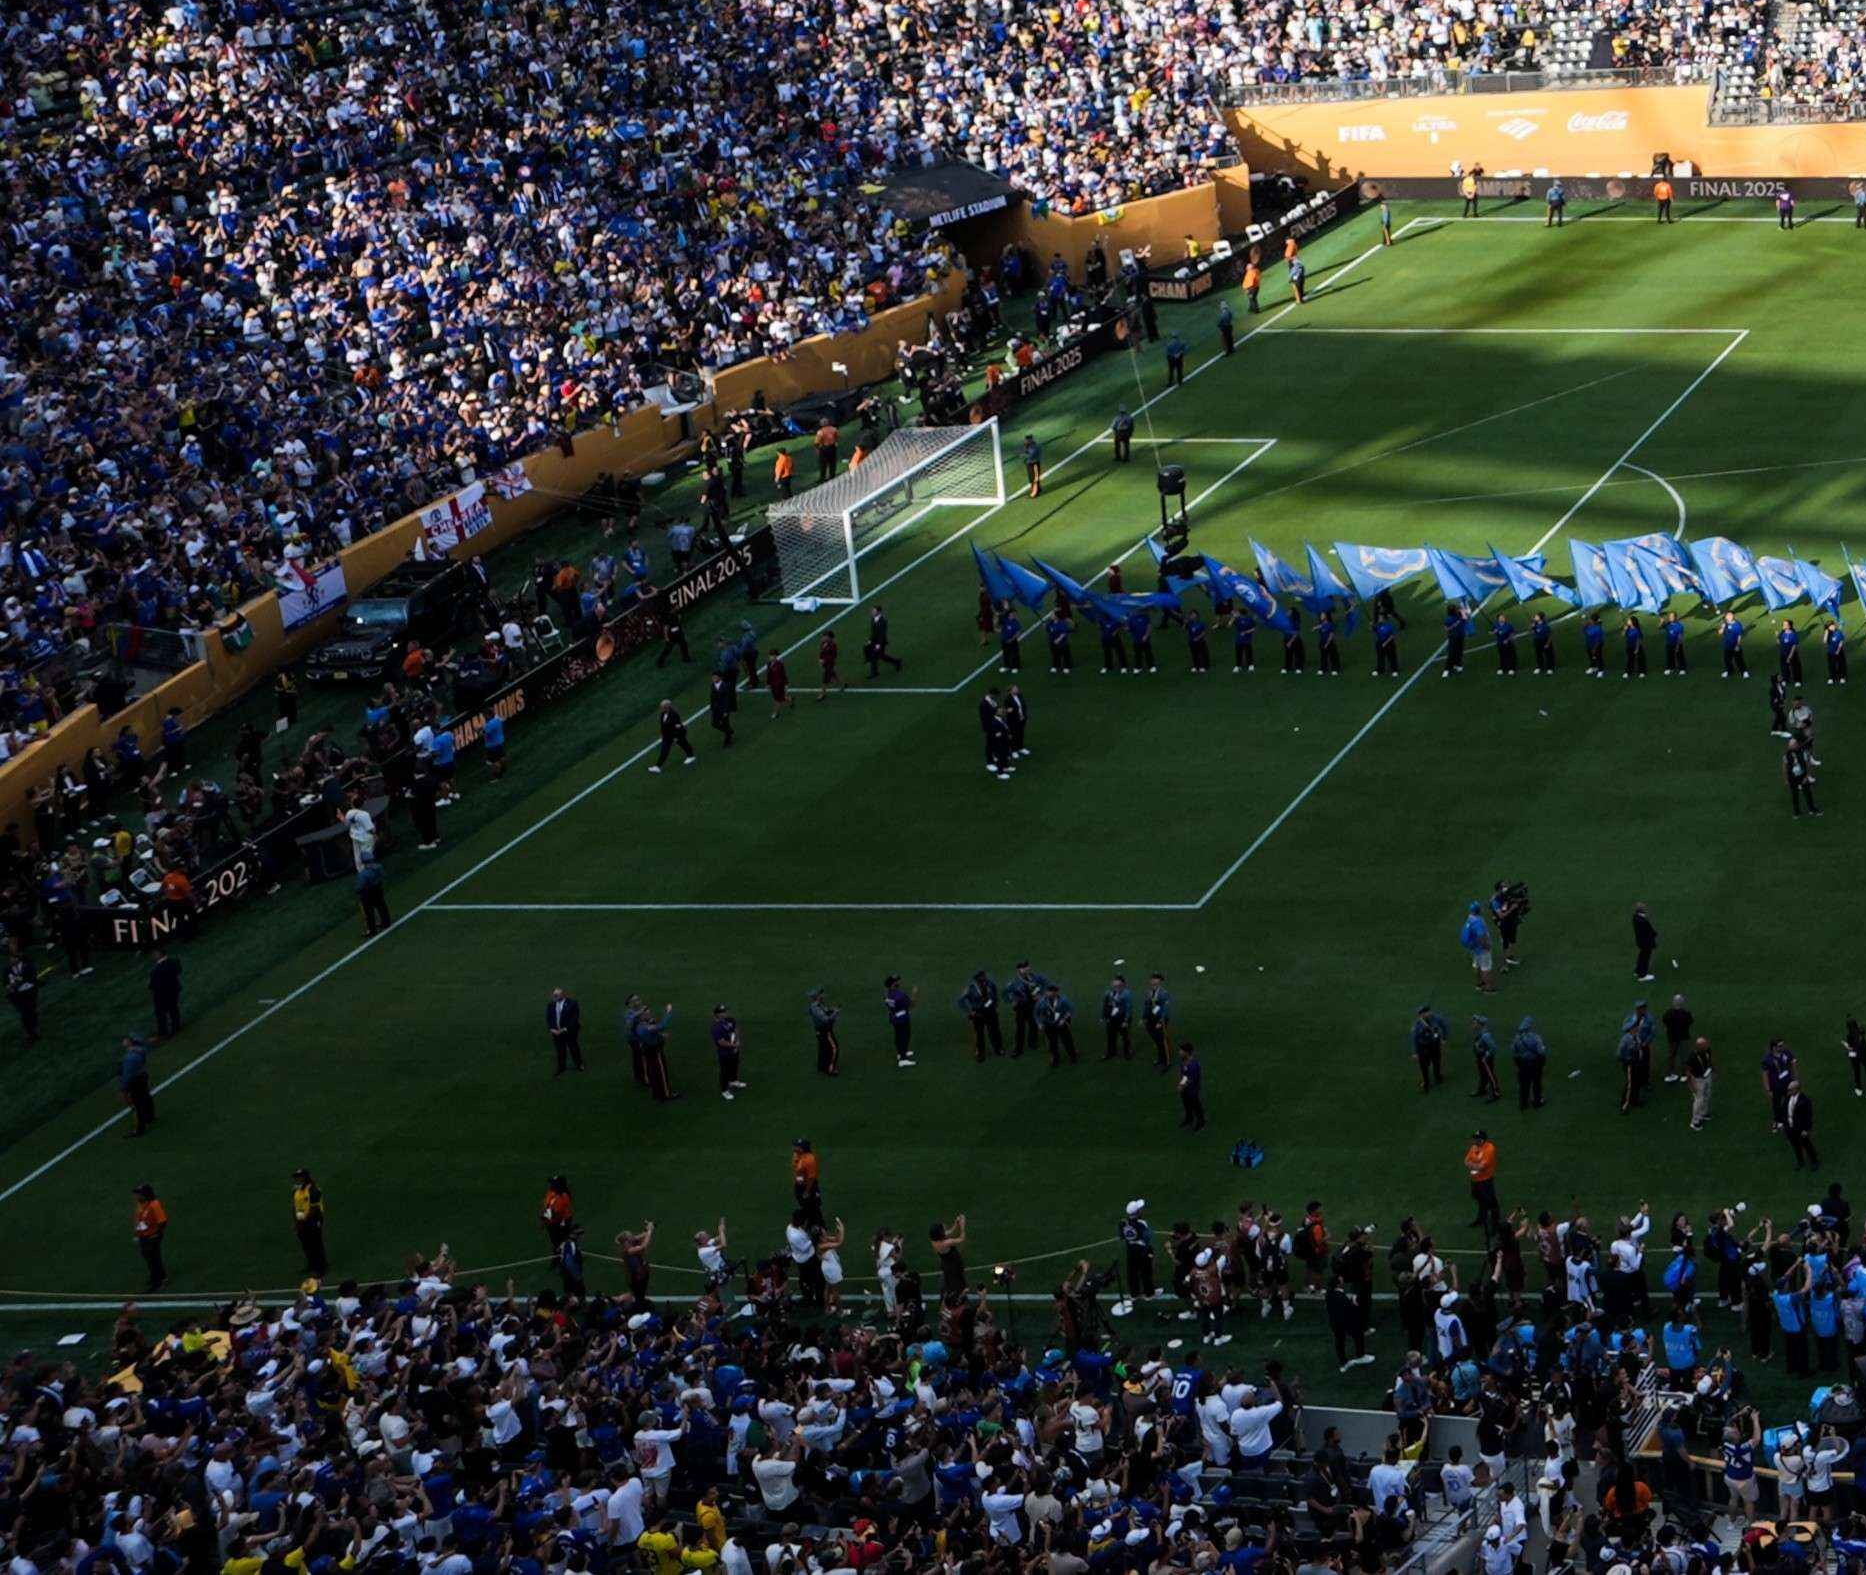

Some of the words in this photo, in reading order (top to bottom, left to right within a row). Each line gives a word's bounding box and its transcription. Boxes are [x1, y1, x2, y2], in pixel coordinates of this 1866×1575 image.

[1339, 125, 1386, 142] FIFA
[1690, 182, 1740, 197] FINAL
[1020, 366, 1054, 397] FINAL
[1053, 347, 1083, 378] 2025
[670, 569, 716, 610] FINAL
[206, 860, 249, 907] 202
